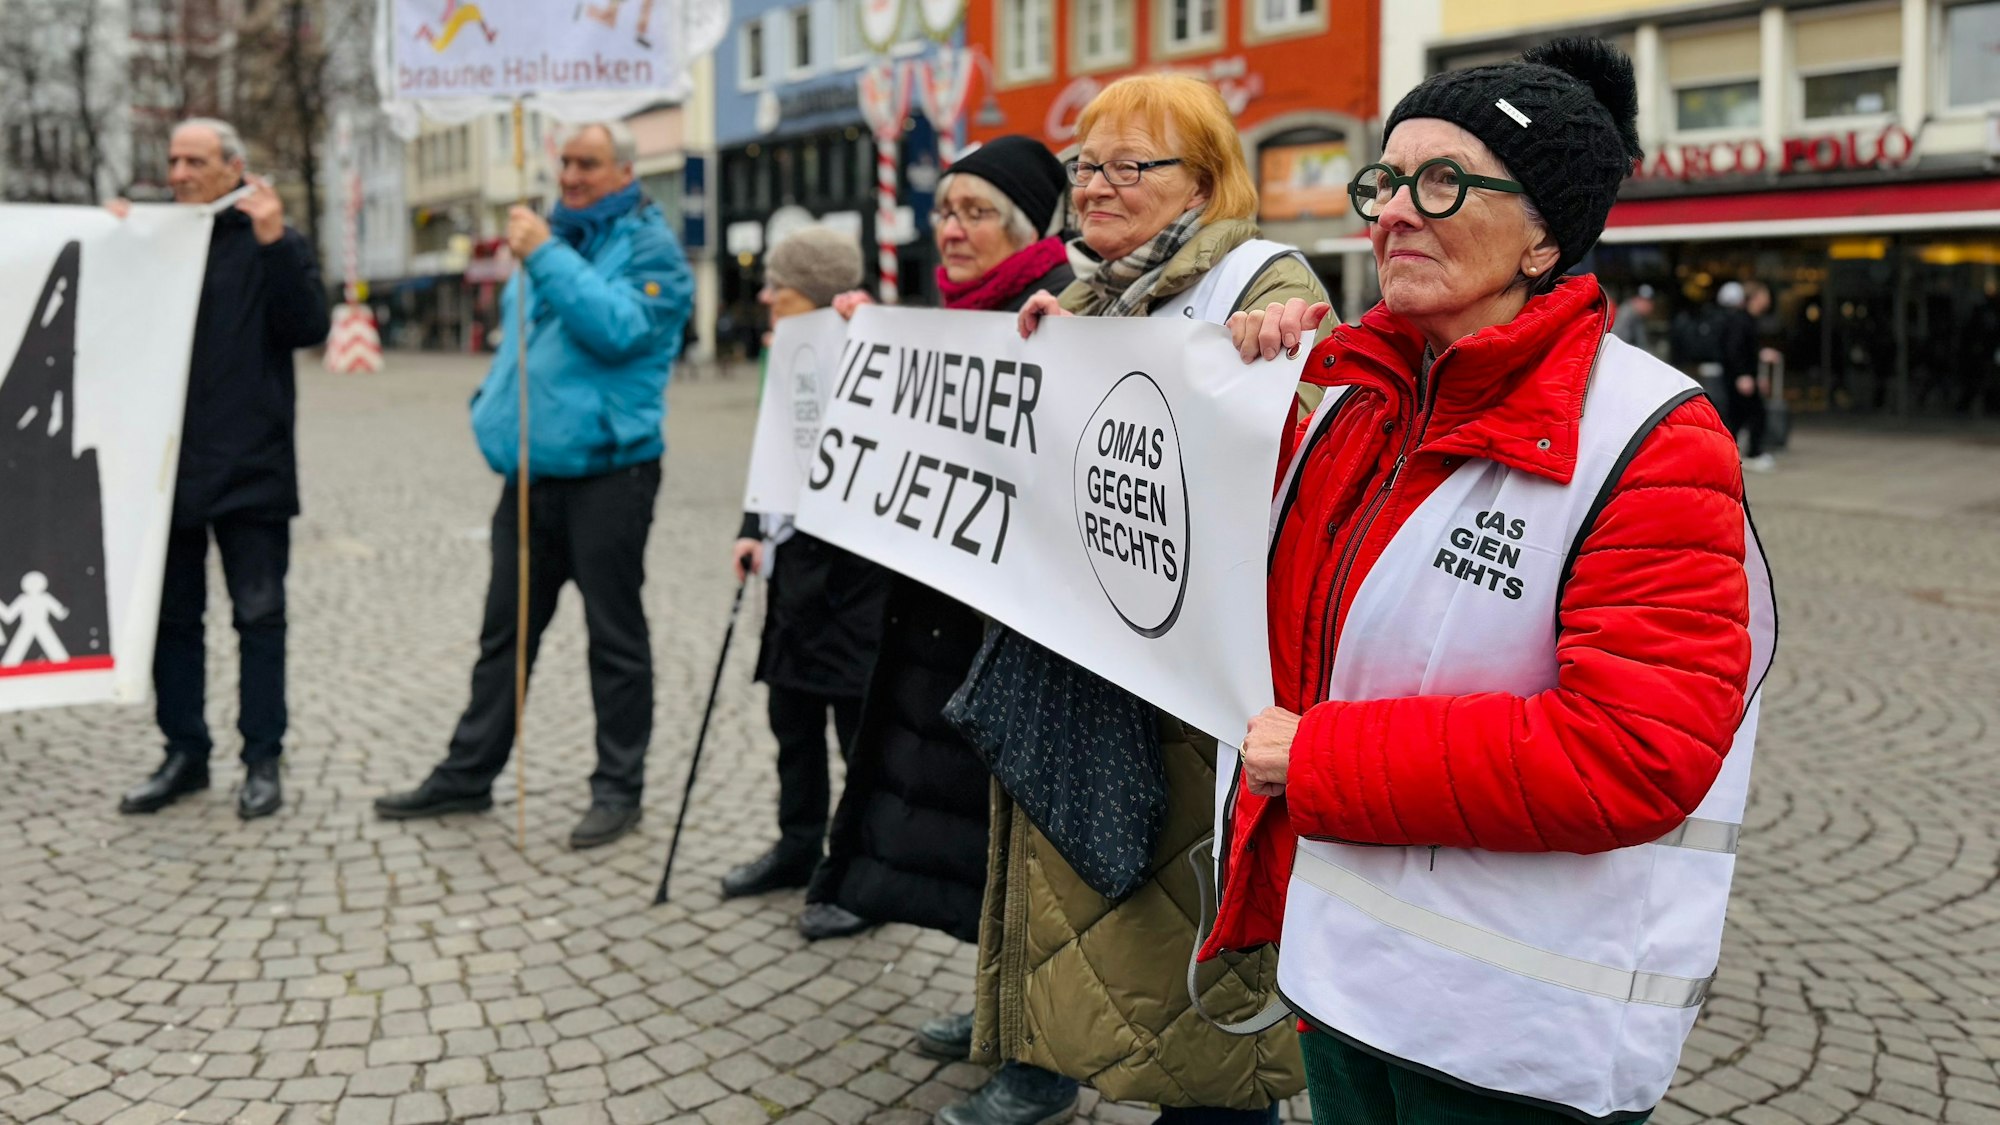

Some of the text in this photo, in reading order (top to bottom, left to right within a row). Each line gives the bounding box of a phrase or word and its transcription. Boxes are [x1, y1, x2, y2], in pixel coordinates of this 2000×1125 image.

[401, 52, 654, 90] braune Halunken
[1781, 124, 1913, 173] POLO
[892, 346, 1043, 454] WIEDER
[1098, 418, 1164, 470] OMAS
[809, 427, 1017, 565] ST JETZT
[1087, 465, 1167, 527] GEGEN
[1085, 511, 1178, 582] RECHTS
